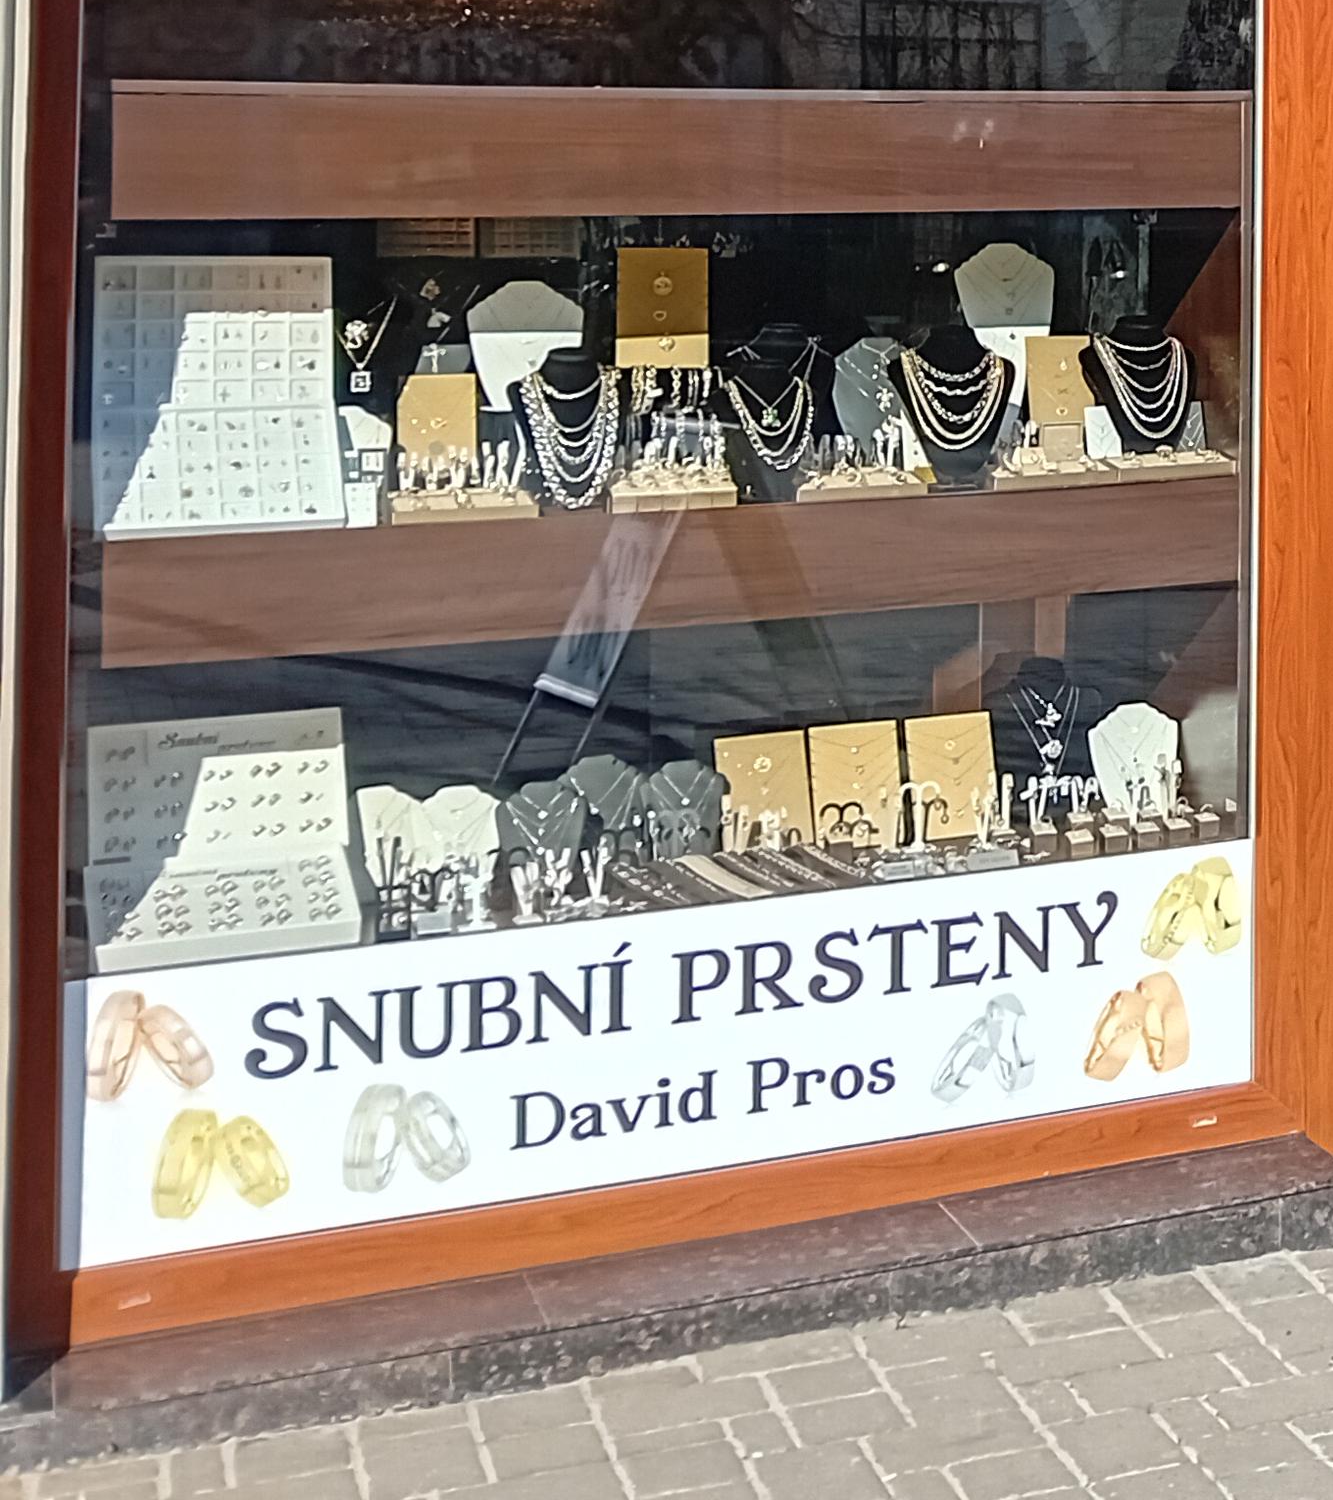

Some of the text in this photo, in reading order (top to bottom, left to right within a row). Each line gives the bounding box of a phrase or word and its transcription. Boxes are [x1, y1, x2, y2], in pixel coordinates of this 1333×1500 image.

[243, 890, 1120, 1081] SNUBNÍ PRSTENY
[509, 1056, 898, 1151] David Pros
